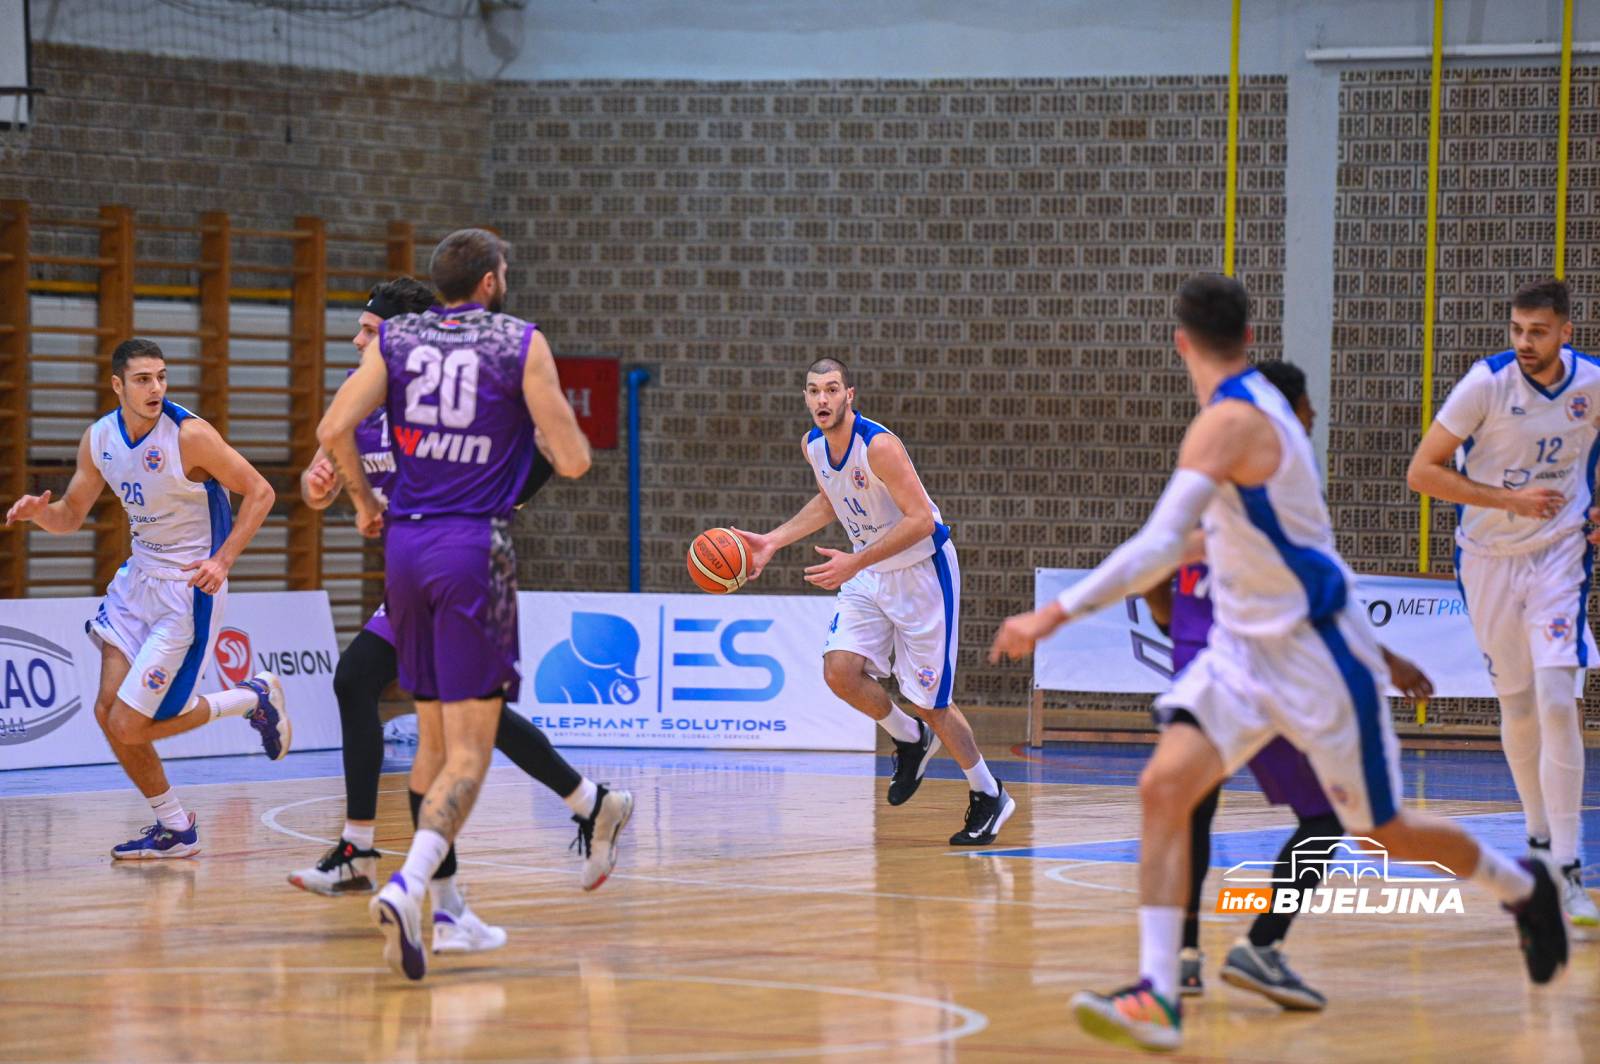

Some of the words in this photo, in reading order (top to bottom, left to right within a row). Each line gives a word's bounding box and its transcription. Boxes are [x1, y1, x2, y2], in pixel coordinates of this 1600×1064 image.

[404, 345, 480, 429] 20
[566, 387, 593, 417] H
[1535, 437, 1562, 464] 12
[121, 482, 145, 506] 26
[843, 497, 867, 517] 14
[258, 650, 333, 676] VISION
[672, 618, 786, 702] ES
[0, 658, 56, 709] AO
[532, 716, 649, 729] ELEPHANT
[661, 718, 787, 731] SOLUTIONS
